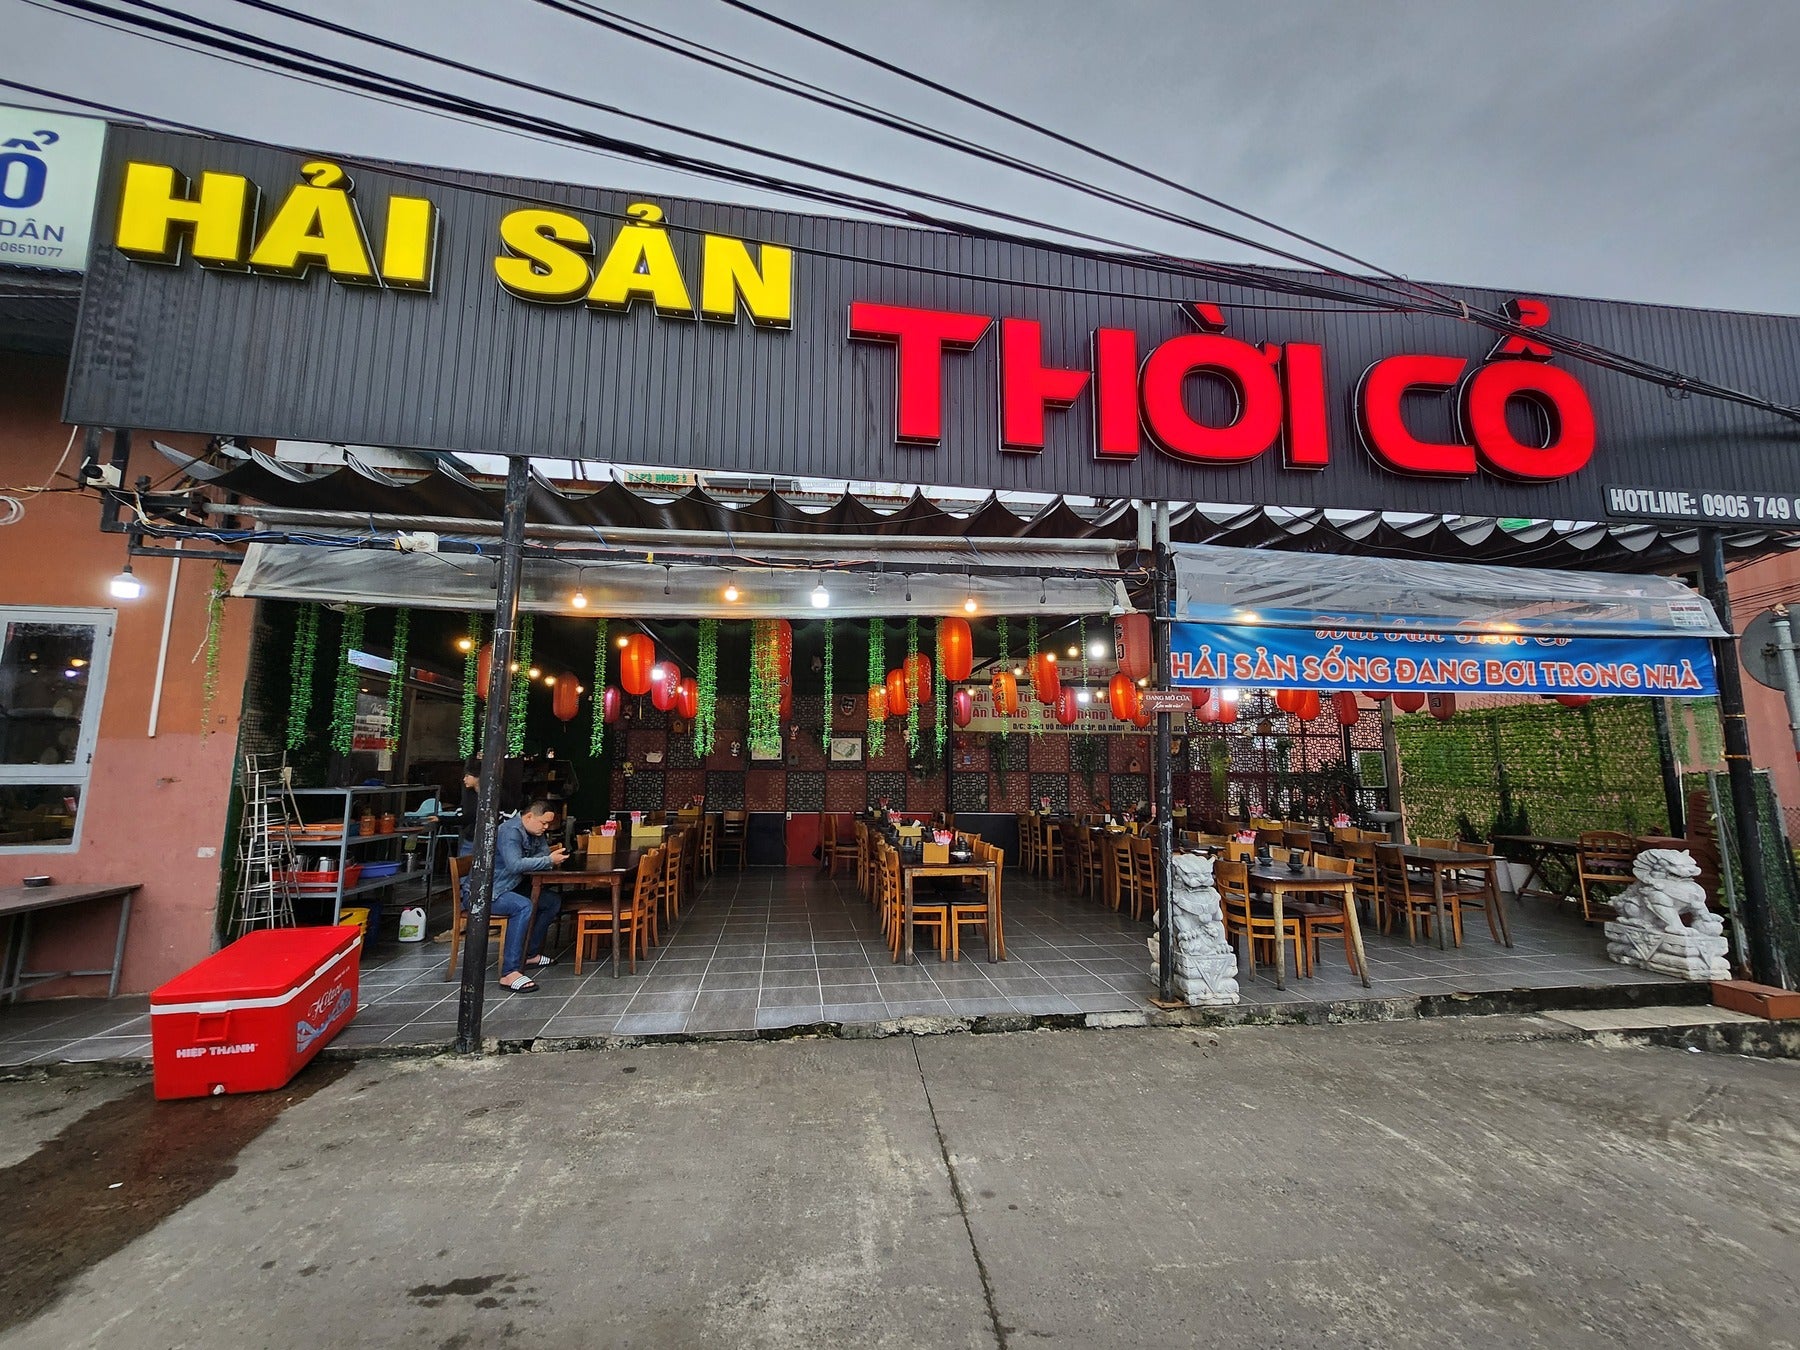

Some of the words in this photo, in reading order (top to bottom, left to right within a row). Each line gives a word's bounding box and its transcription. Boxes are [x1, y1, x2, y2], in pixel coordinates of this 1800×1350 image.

[118, 162, 432, 286] HẢI
[494, 203, 793, 326] SẢN
[850, 301, 1330, 466] THỜI
[1364, 300, 1596, 480] CỔ
[1609, 487, 1699, 516] HOTLINE:
[1701, 493, 1750, 519] 0905
[1753, 496, 1791, 521] 749
[1170, 645, 1227, 679] HẢI
[1233, 646, 1298, 682] SẢN
[1303, 645, 1391, 683] SỐNG
[1395, 657, 1480, 686] ĐANG
[1485, 659, 1537, 687] BƠI
[1540, 661, 1640, 689] TRONG
[1645, 658, 1703, 690] NHÀ
